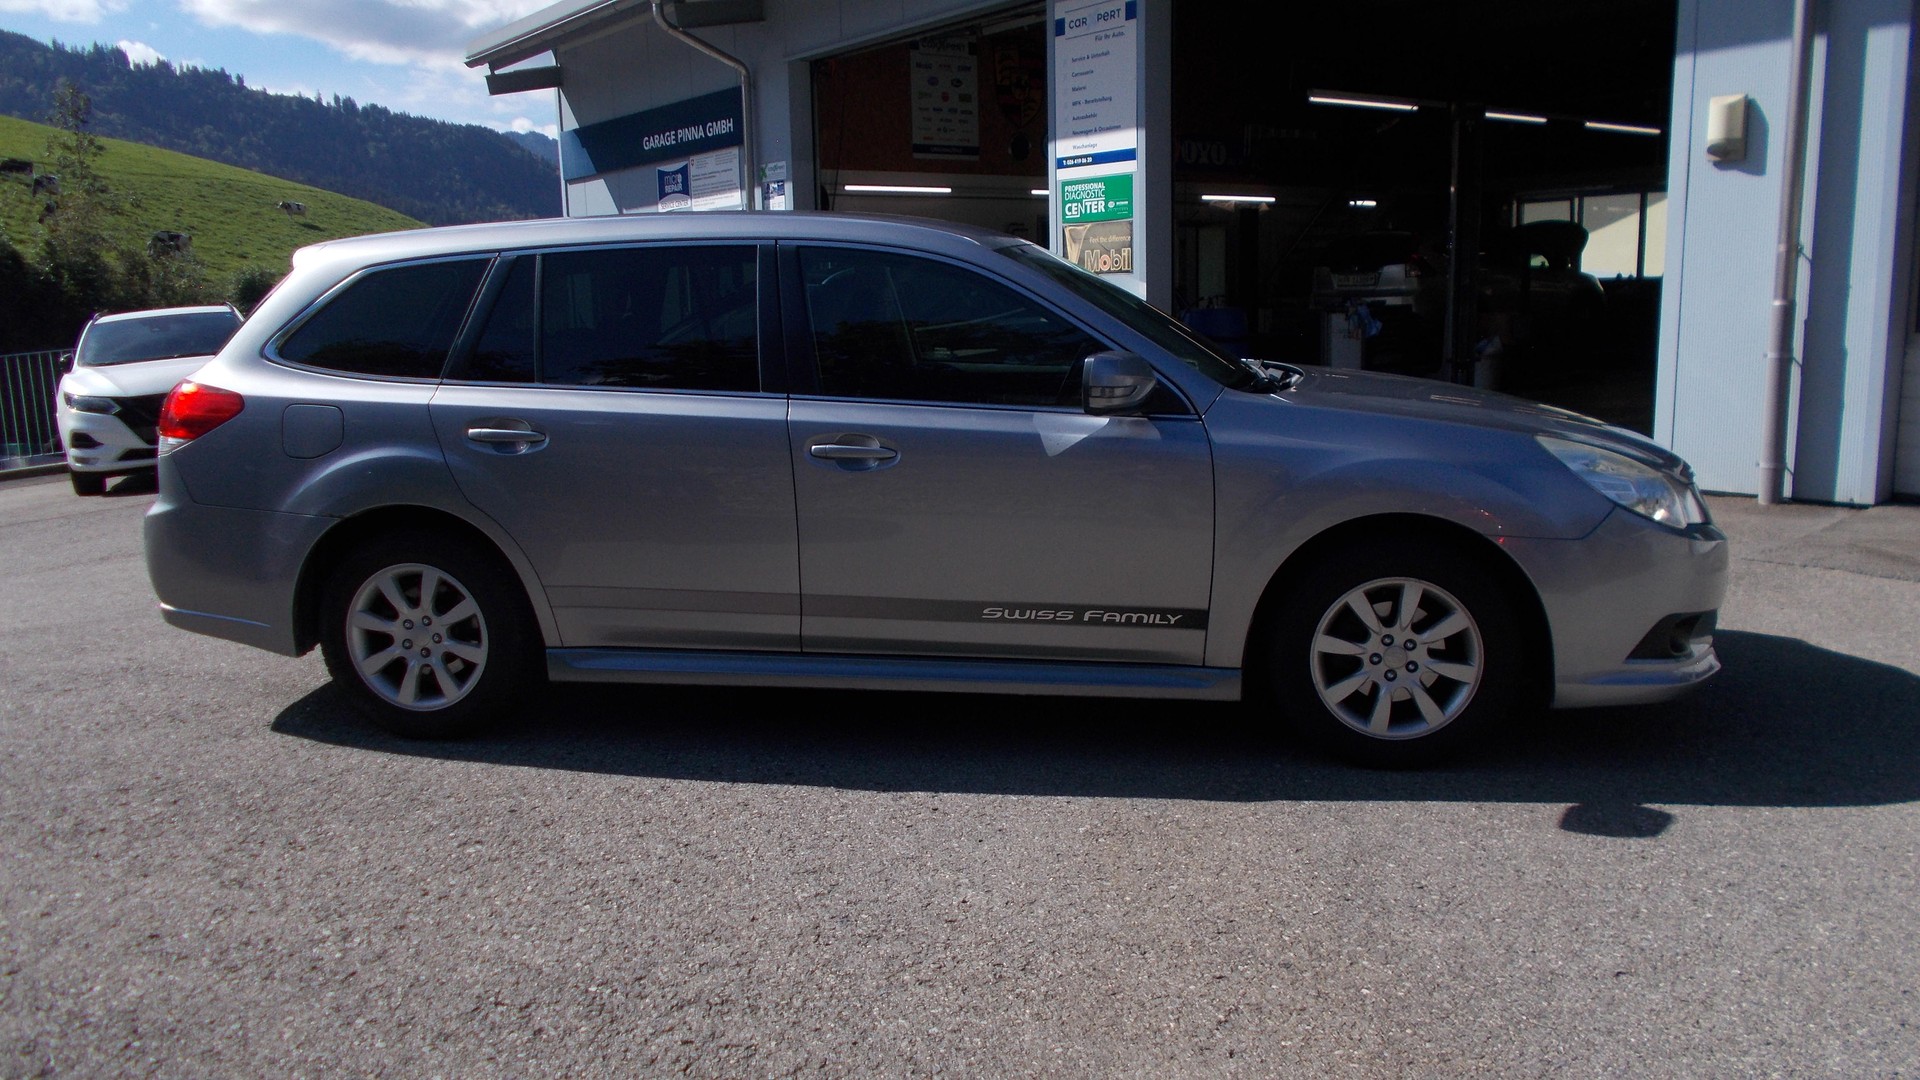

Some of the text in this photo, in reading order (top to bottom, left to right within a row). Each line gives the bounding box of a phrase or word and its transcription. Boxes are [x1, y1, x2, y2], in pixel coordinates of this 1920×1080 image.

[643, 117, 734, 150] GARAGE PINNA GMBH
[665, 183, 683, 193] REPAIR
[1064, 182, 1105, 193] PROFESSIONAL
[1064, 189, 1105, 200] DIAGNOSTIC
[1065, 200, 1105, 216] CENTER
[1089, 236, 1099, 244] Feel
[1084, 247, 1132, 272] Mobil
